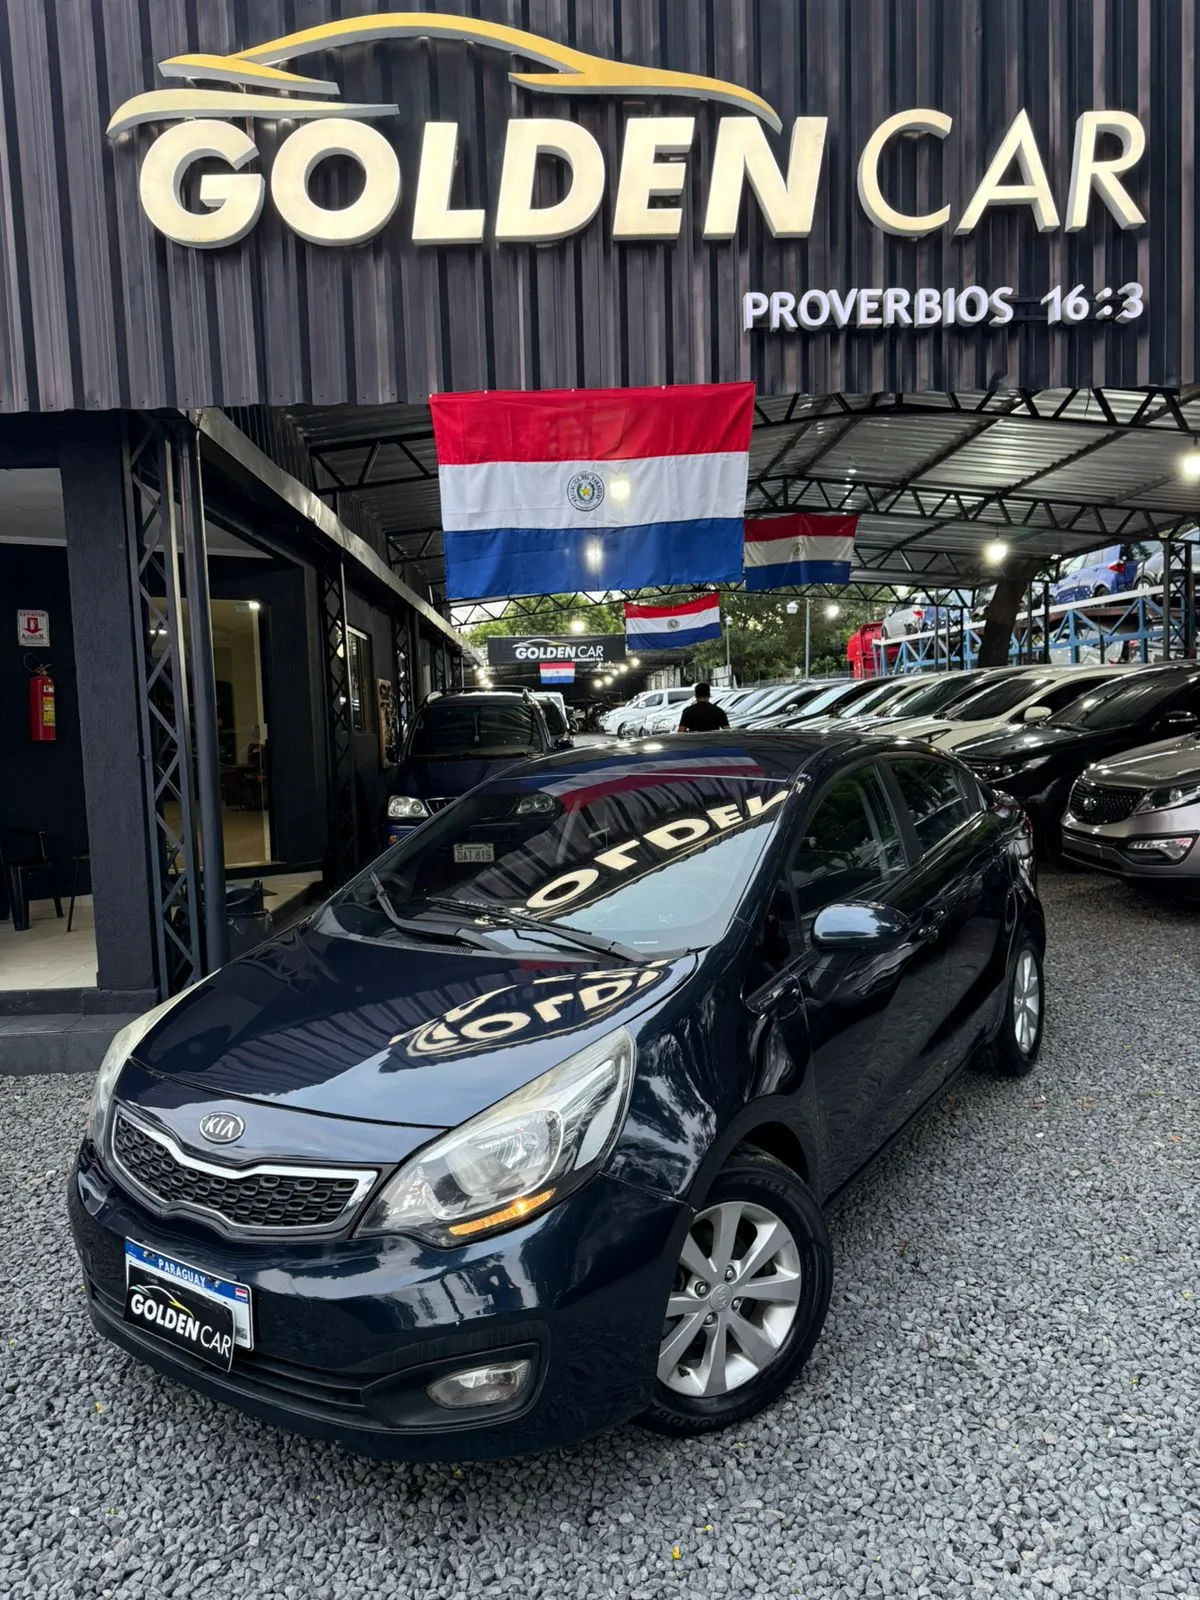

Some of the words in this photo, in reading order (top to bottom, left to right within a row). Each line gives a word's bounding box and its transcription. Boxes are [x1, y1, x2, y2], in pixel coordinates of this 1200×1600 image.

[139, 116, 828, 249] GOLDEN
[857, 108, 1148, 237] CAR
[743, 285, 1014, 332] PROVERBIOS
[1041, 282, 1145, 326] 16:3
[515, 646, 577, 659] GOLDEN
[577, 645, 604, 658] CAR
[204, 1116, 235, 1138] KIA
[158, 1258, 206, 1288] PARAGUAY
[130, 1293, 200, 1341] GOLDEN
[200, 1325, 232, 1358] CAR
